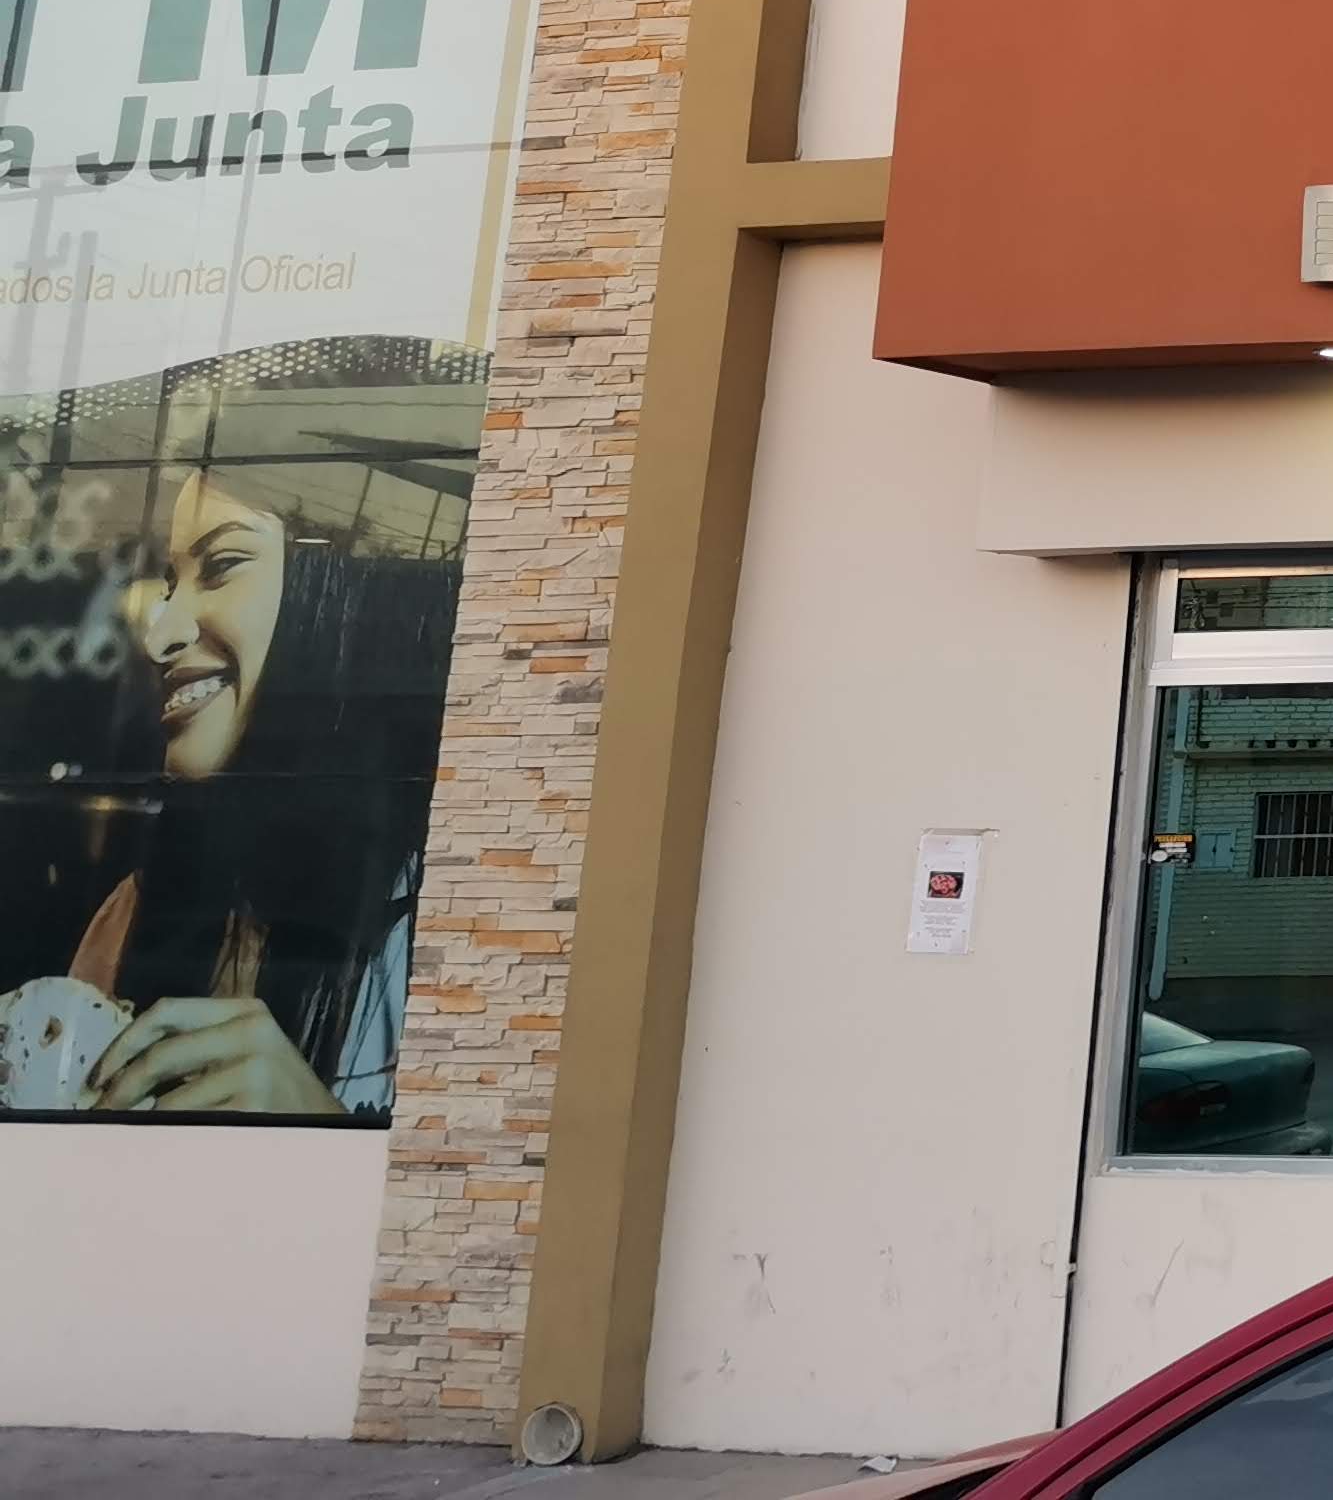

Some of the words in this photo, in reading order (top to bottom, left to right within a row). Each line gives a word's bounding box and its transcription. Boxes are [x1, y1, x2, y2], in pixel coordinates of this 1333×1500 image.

[76, 85, 414, 186] Junta
[87, 264, 114, 302] la
[127, 260, 226, 301] Junta
[240, 251, 357, 293] Oficial
